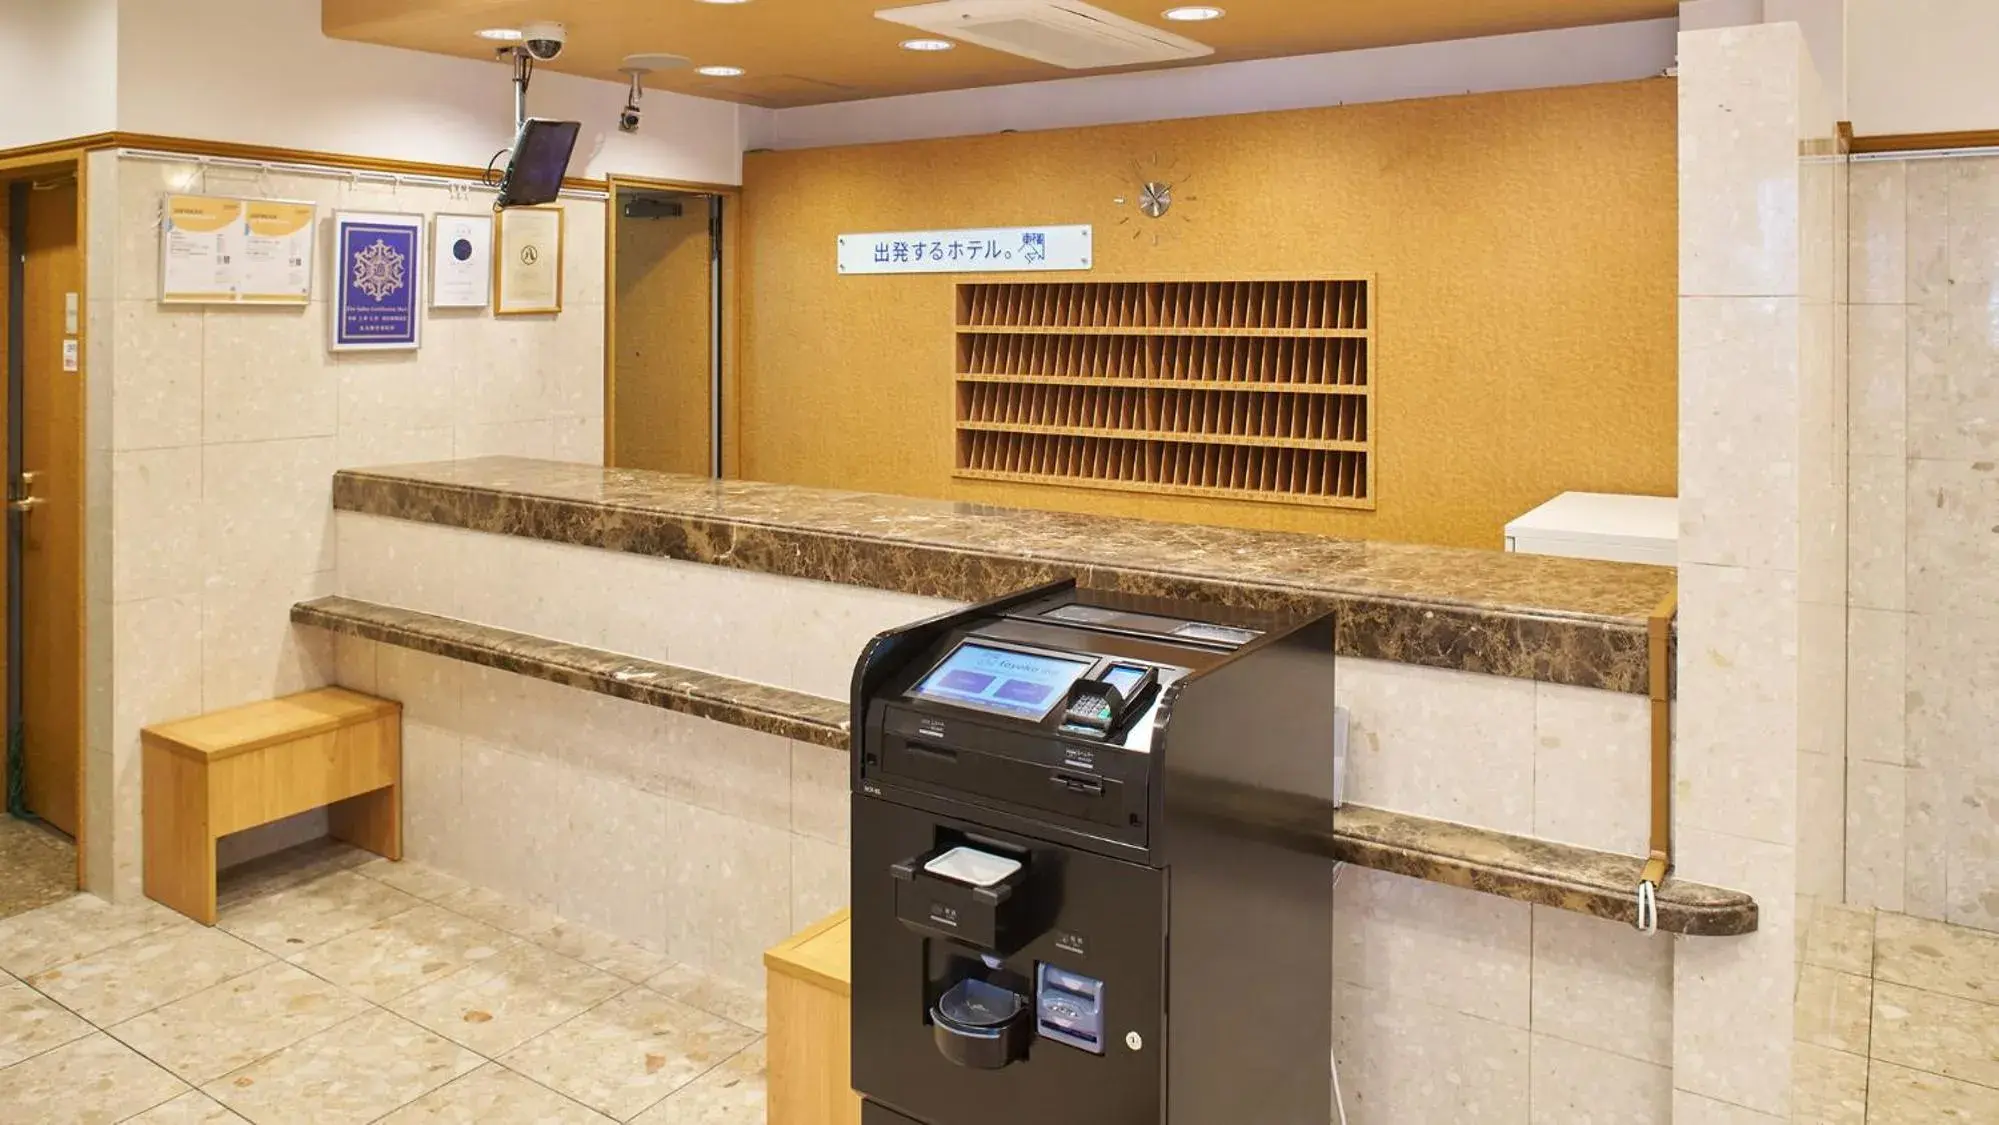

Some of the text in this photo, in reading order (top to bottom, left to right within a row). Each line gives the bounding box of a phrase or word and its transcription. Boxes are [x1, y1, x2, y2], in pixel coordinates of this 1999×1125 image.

[874, 239, 1012, 262] 出発するホテル。
